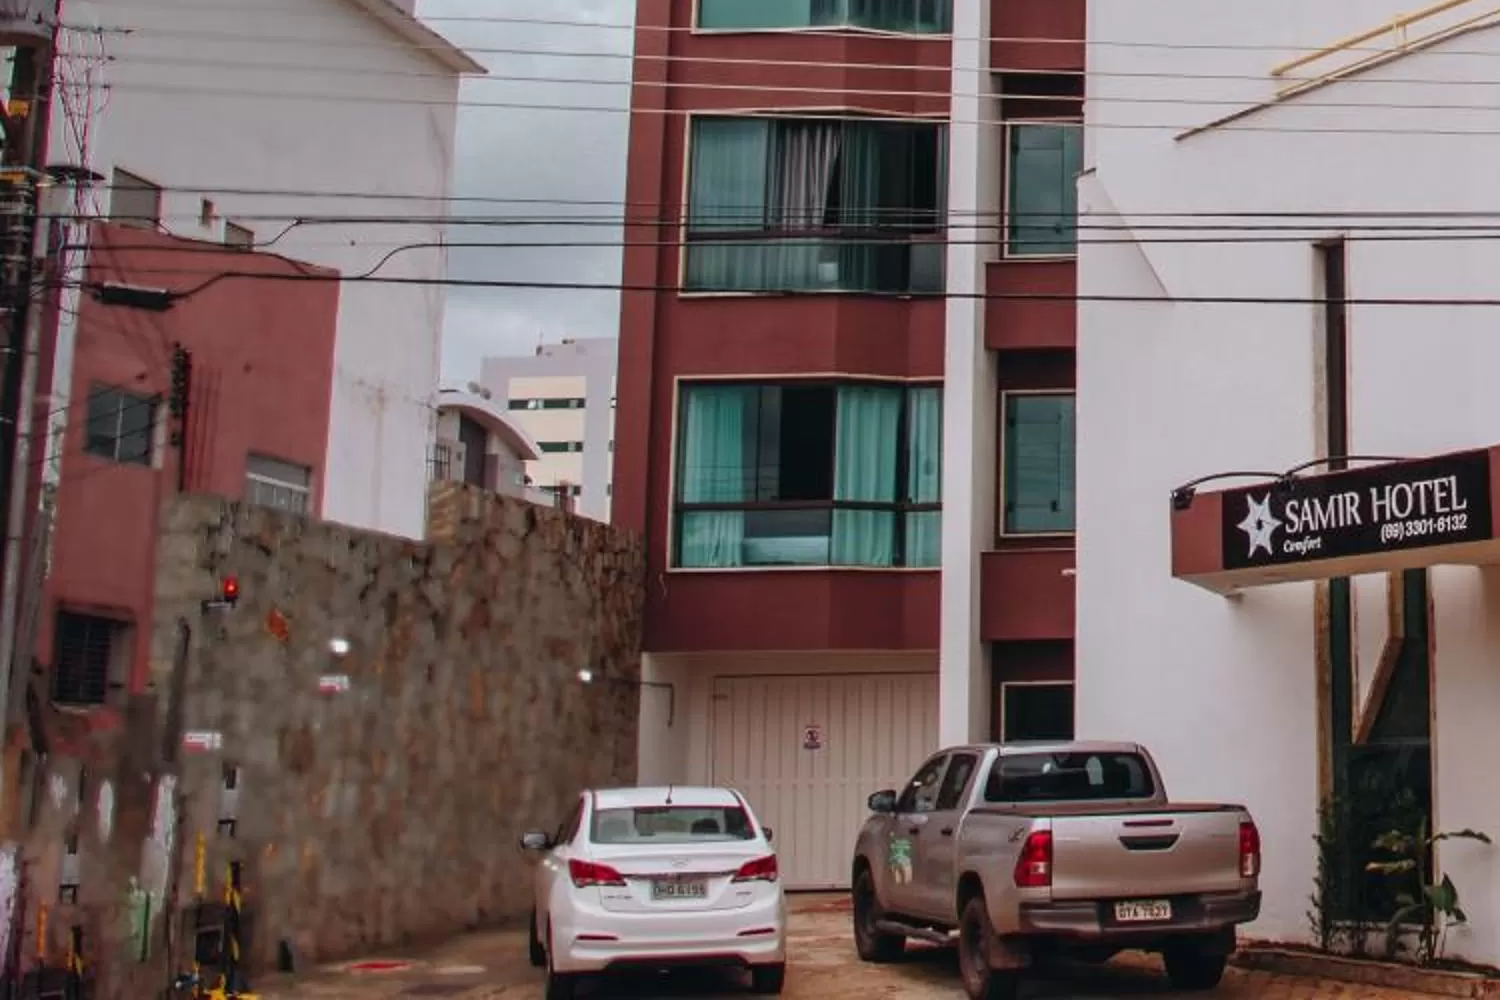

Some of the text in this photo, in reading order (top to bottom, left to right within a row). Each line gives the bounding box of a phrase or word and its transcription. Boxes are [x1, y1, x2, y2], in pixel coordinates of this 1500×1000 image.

[1285, 475, 1467, 533] SAMIR HOTEL
[1381, 523, 1404, 544] (69)
[1283, 536, 1321, 555] Comfort
